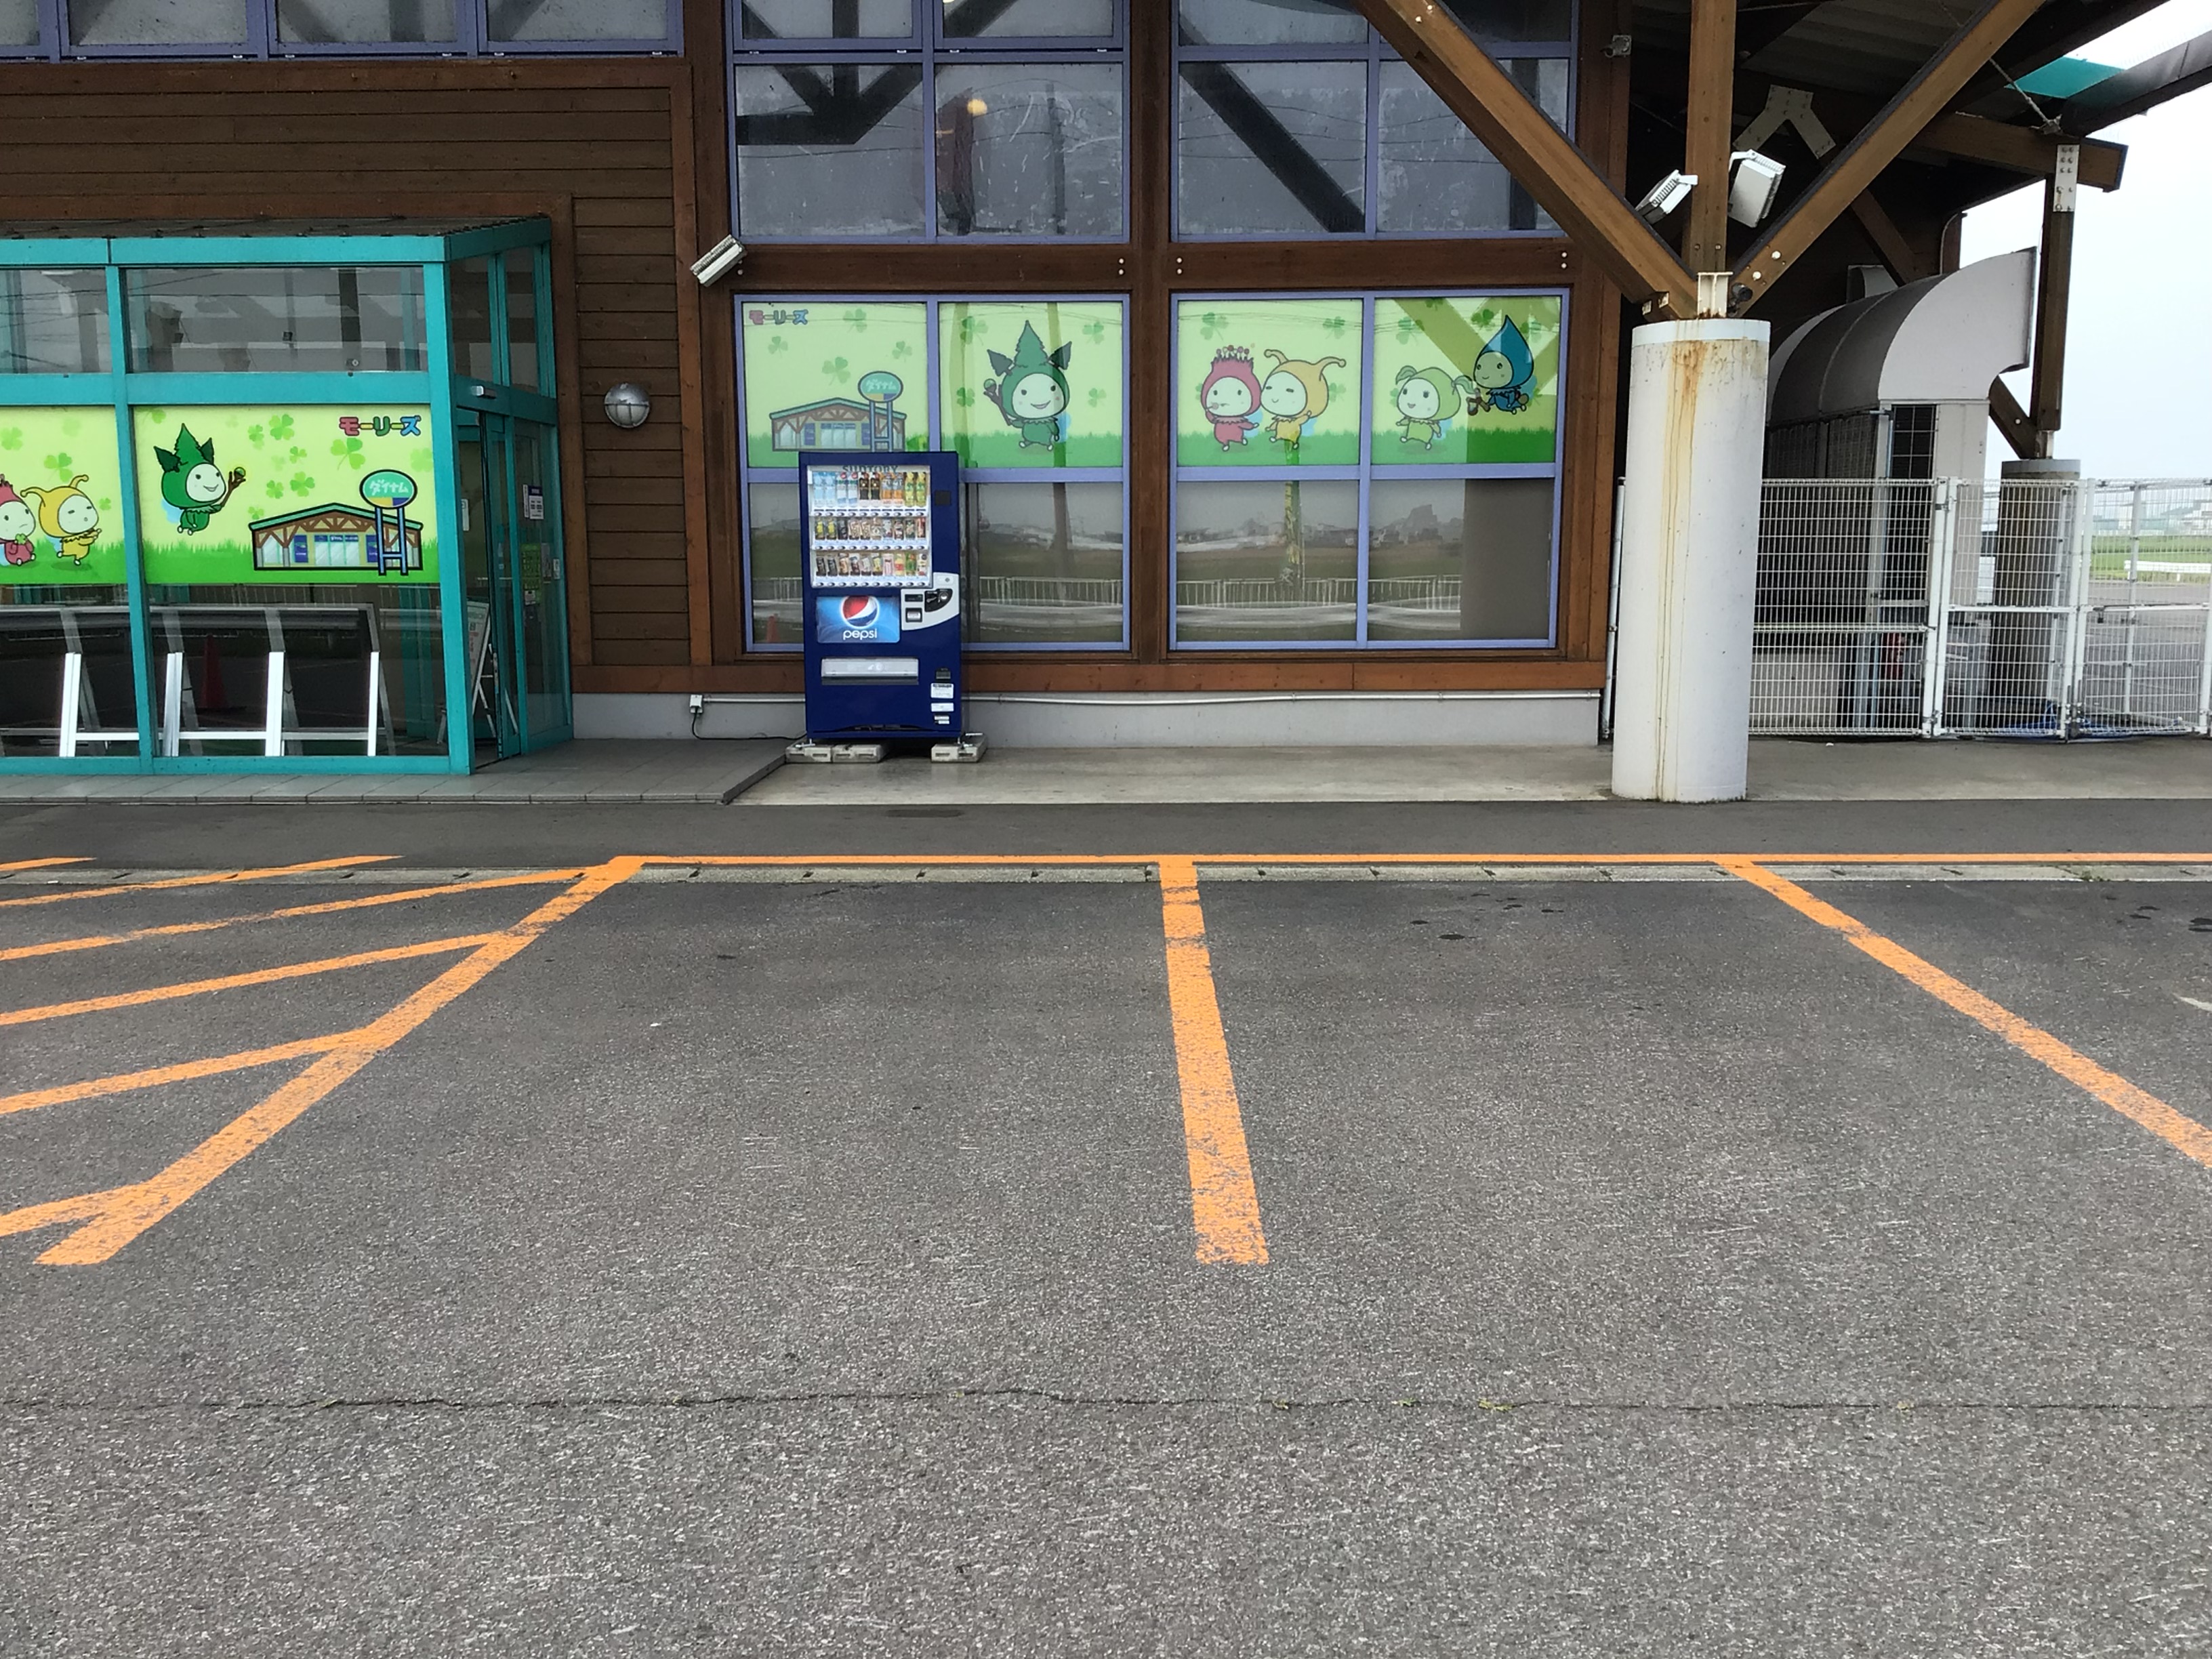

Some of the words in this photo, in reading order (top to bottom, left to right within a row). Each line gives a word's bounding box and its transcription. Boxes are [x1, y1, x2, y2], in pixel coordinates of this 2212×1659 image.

[749, 309, 808, 325] モーリーズ
[339, 415, 422, 436] モーリーズ
[369, 479, 409, 495] ダイナム
[843, 628, 877, 640] pepsi
